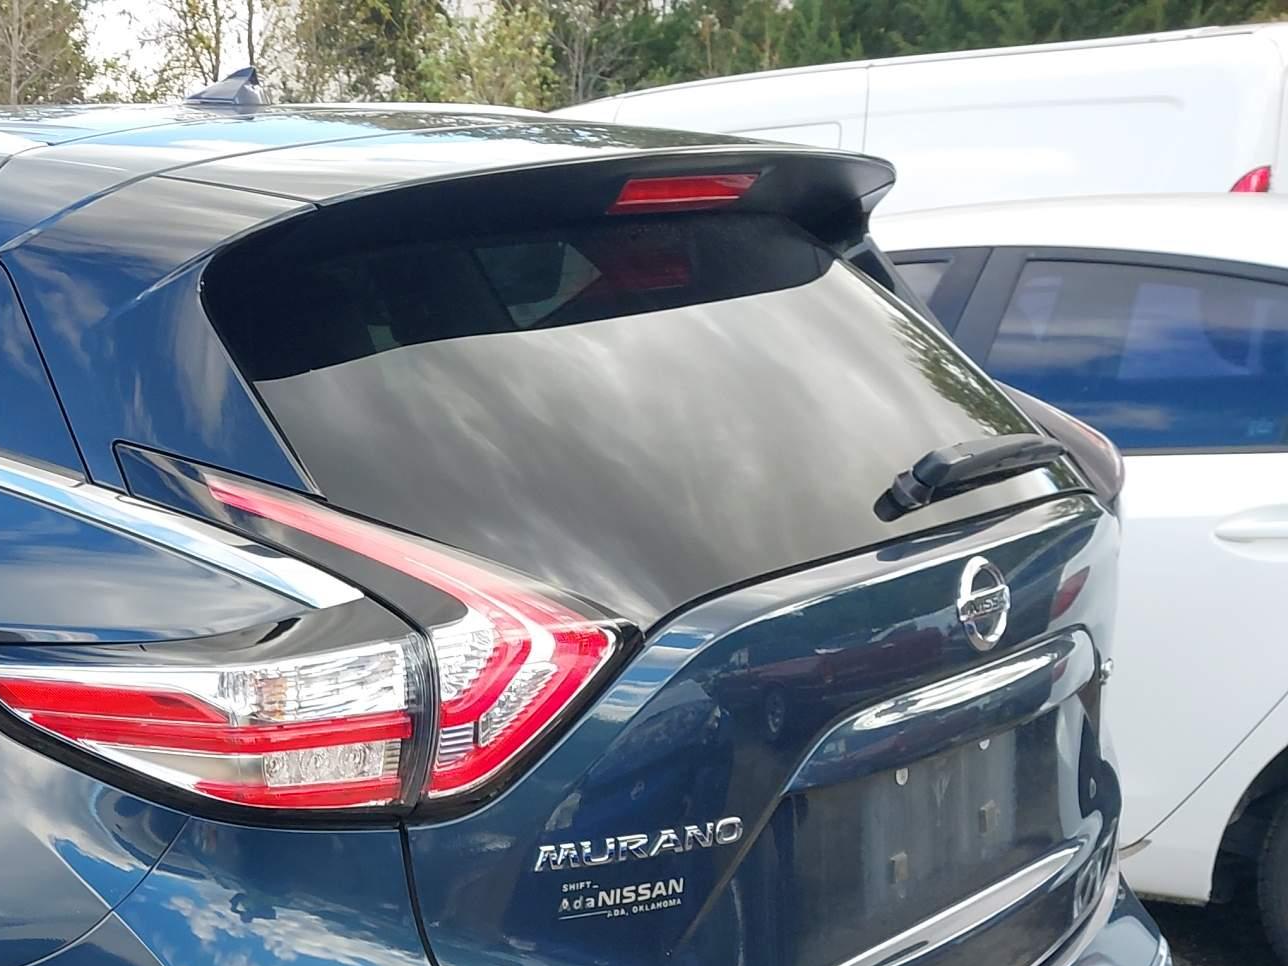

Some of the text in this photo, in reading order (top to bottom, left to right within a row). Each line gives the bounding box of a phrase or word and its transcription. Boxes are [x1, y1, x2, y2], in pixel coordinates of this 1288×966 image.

[966, 590, 1008, 616] NISS
[534, 816, 743, 872] MURANO
[597, 877, 684, 907] NISSAN
[632, 898, 682, 913] OKLAHOMA
